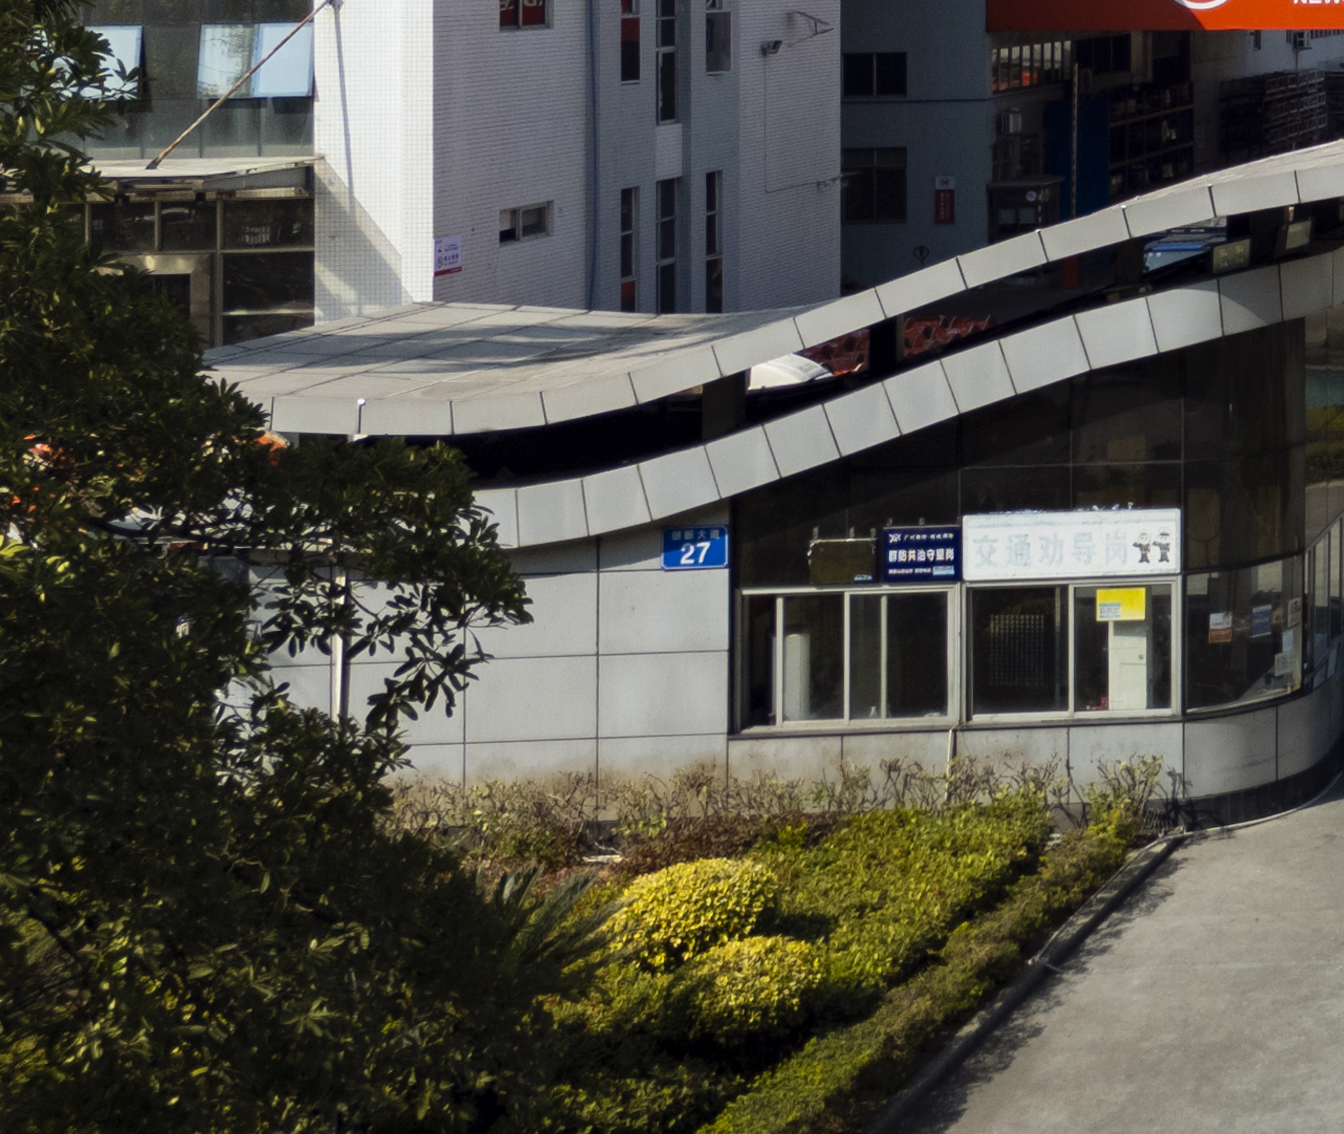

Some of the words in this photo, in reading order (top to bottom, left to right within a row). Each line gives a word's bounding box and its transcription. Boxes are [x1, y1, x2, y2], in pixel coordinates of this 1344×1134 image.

[680, 541, 711, 565] 27
[972, 531, 1128, 568] 交通劝导岗
